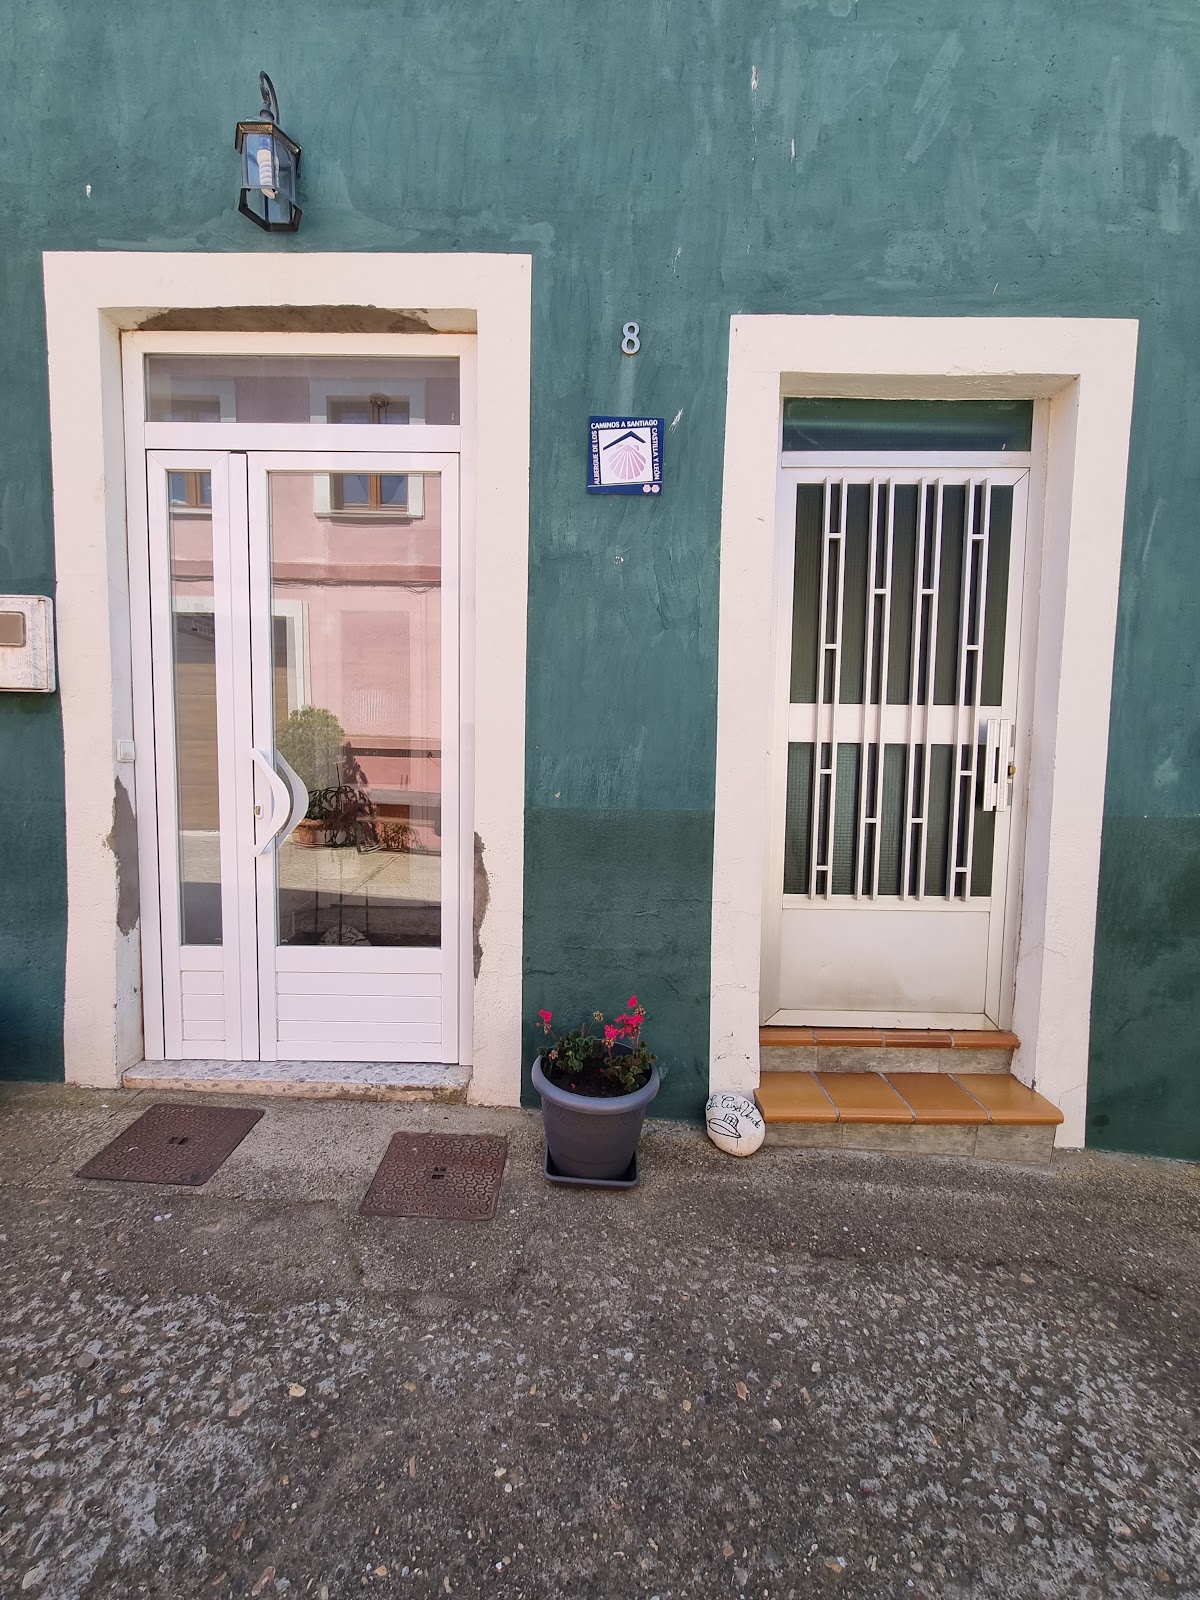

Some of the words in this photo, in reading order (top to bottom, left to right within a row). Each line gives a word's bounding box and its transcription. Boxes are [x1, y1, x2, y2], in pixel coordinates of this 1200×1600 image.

[621, 321, 641, 355] 8
[590, 421, 620, 430] CAMINOS
[626, 419, 658, 428] SANTIAGO
[592, 443, 599, 453] DE
[651, 427, 659, 458] CASTILLA
[592, 453, 600, 485] ALBERGUE
[653, 463, 661, 480] LEÓN
